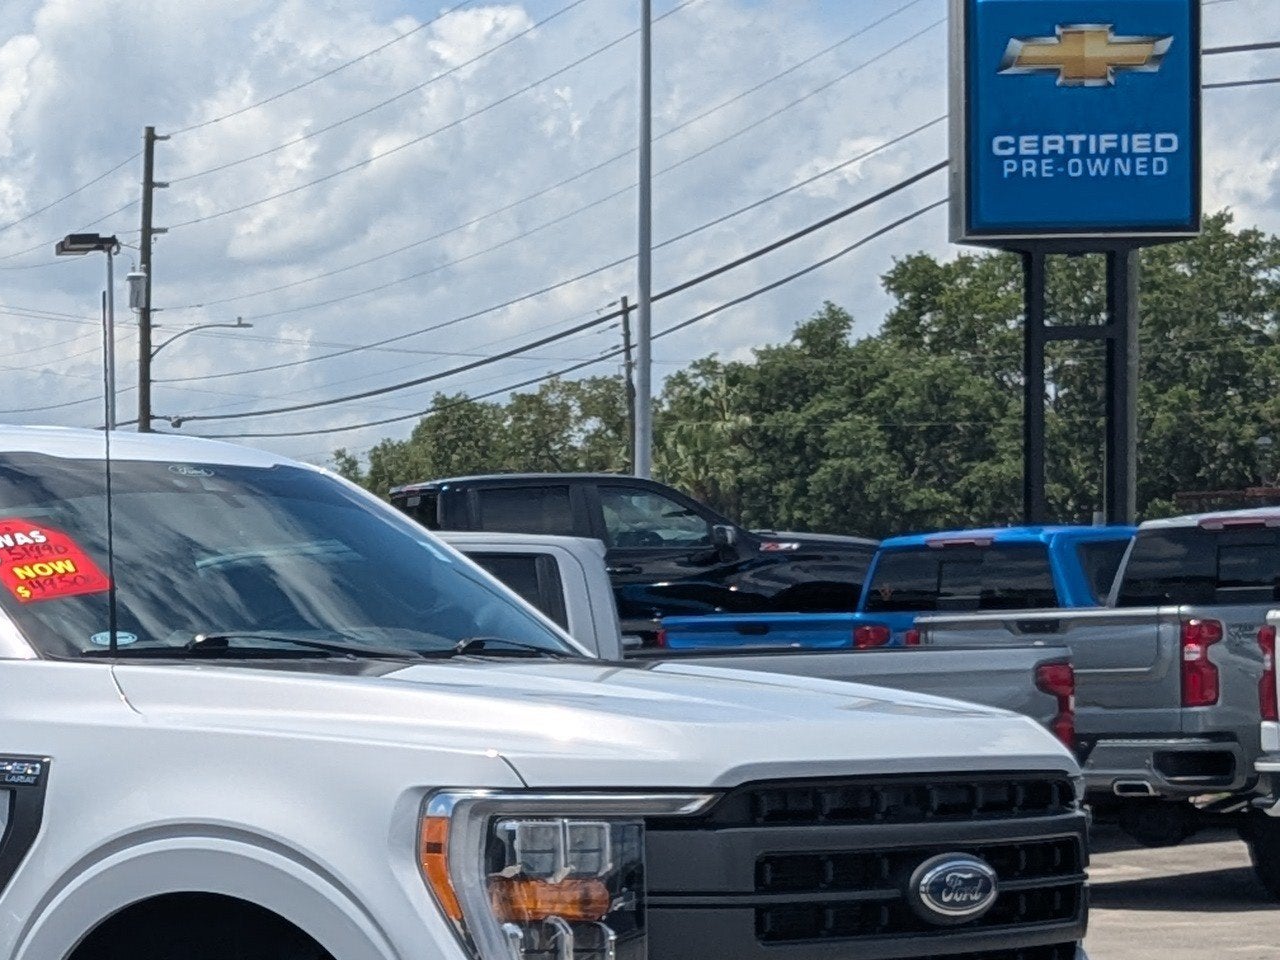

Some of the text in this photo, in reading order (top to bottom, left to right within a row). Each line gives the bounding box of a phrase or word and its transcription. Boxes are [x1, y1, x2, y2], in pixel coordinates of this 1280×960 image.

[992, 133, 1179, 155] CERTIFIED
[1003, 157, 1168, 178] PRE-OWNED
[13, 559, 76, 580] NOW
[941, 872, 983, 902] Ford
